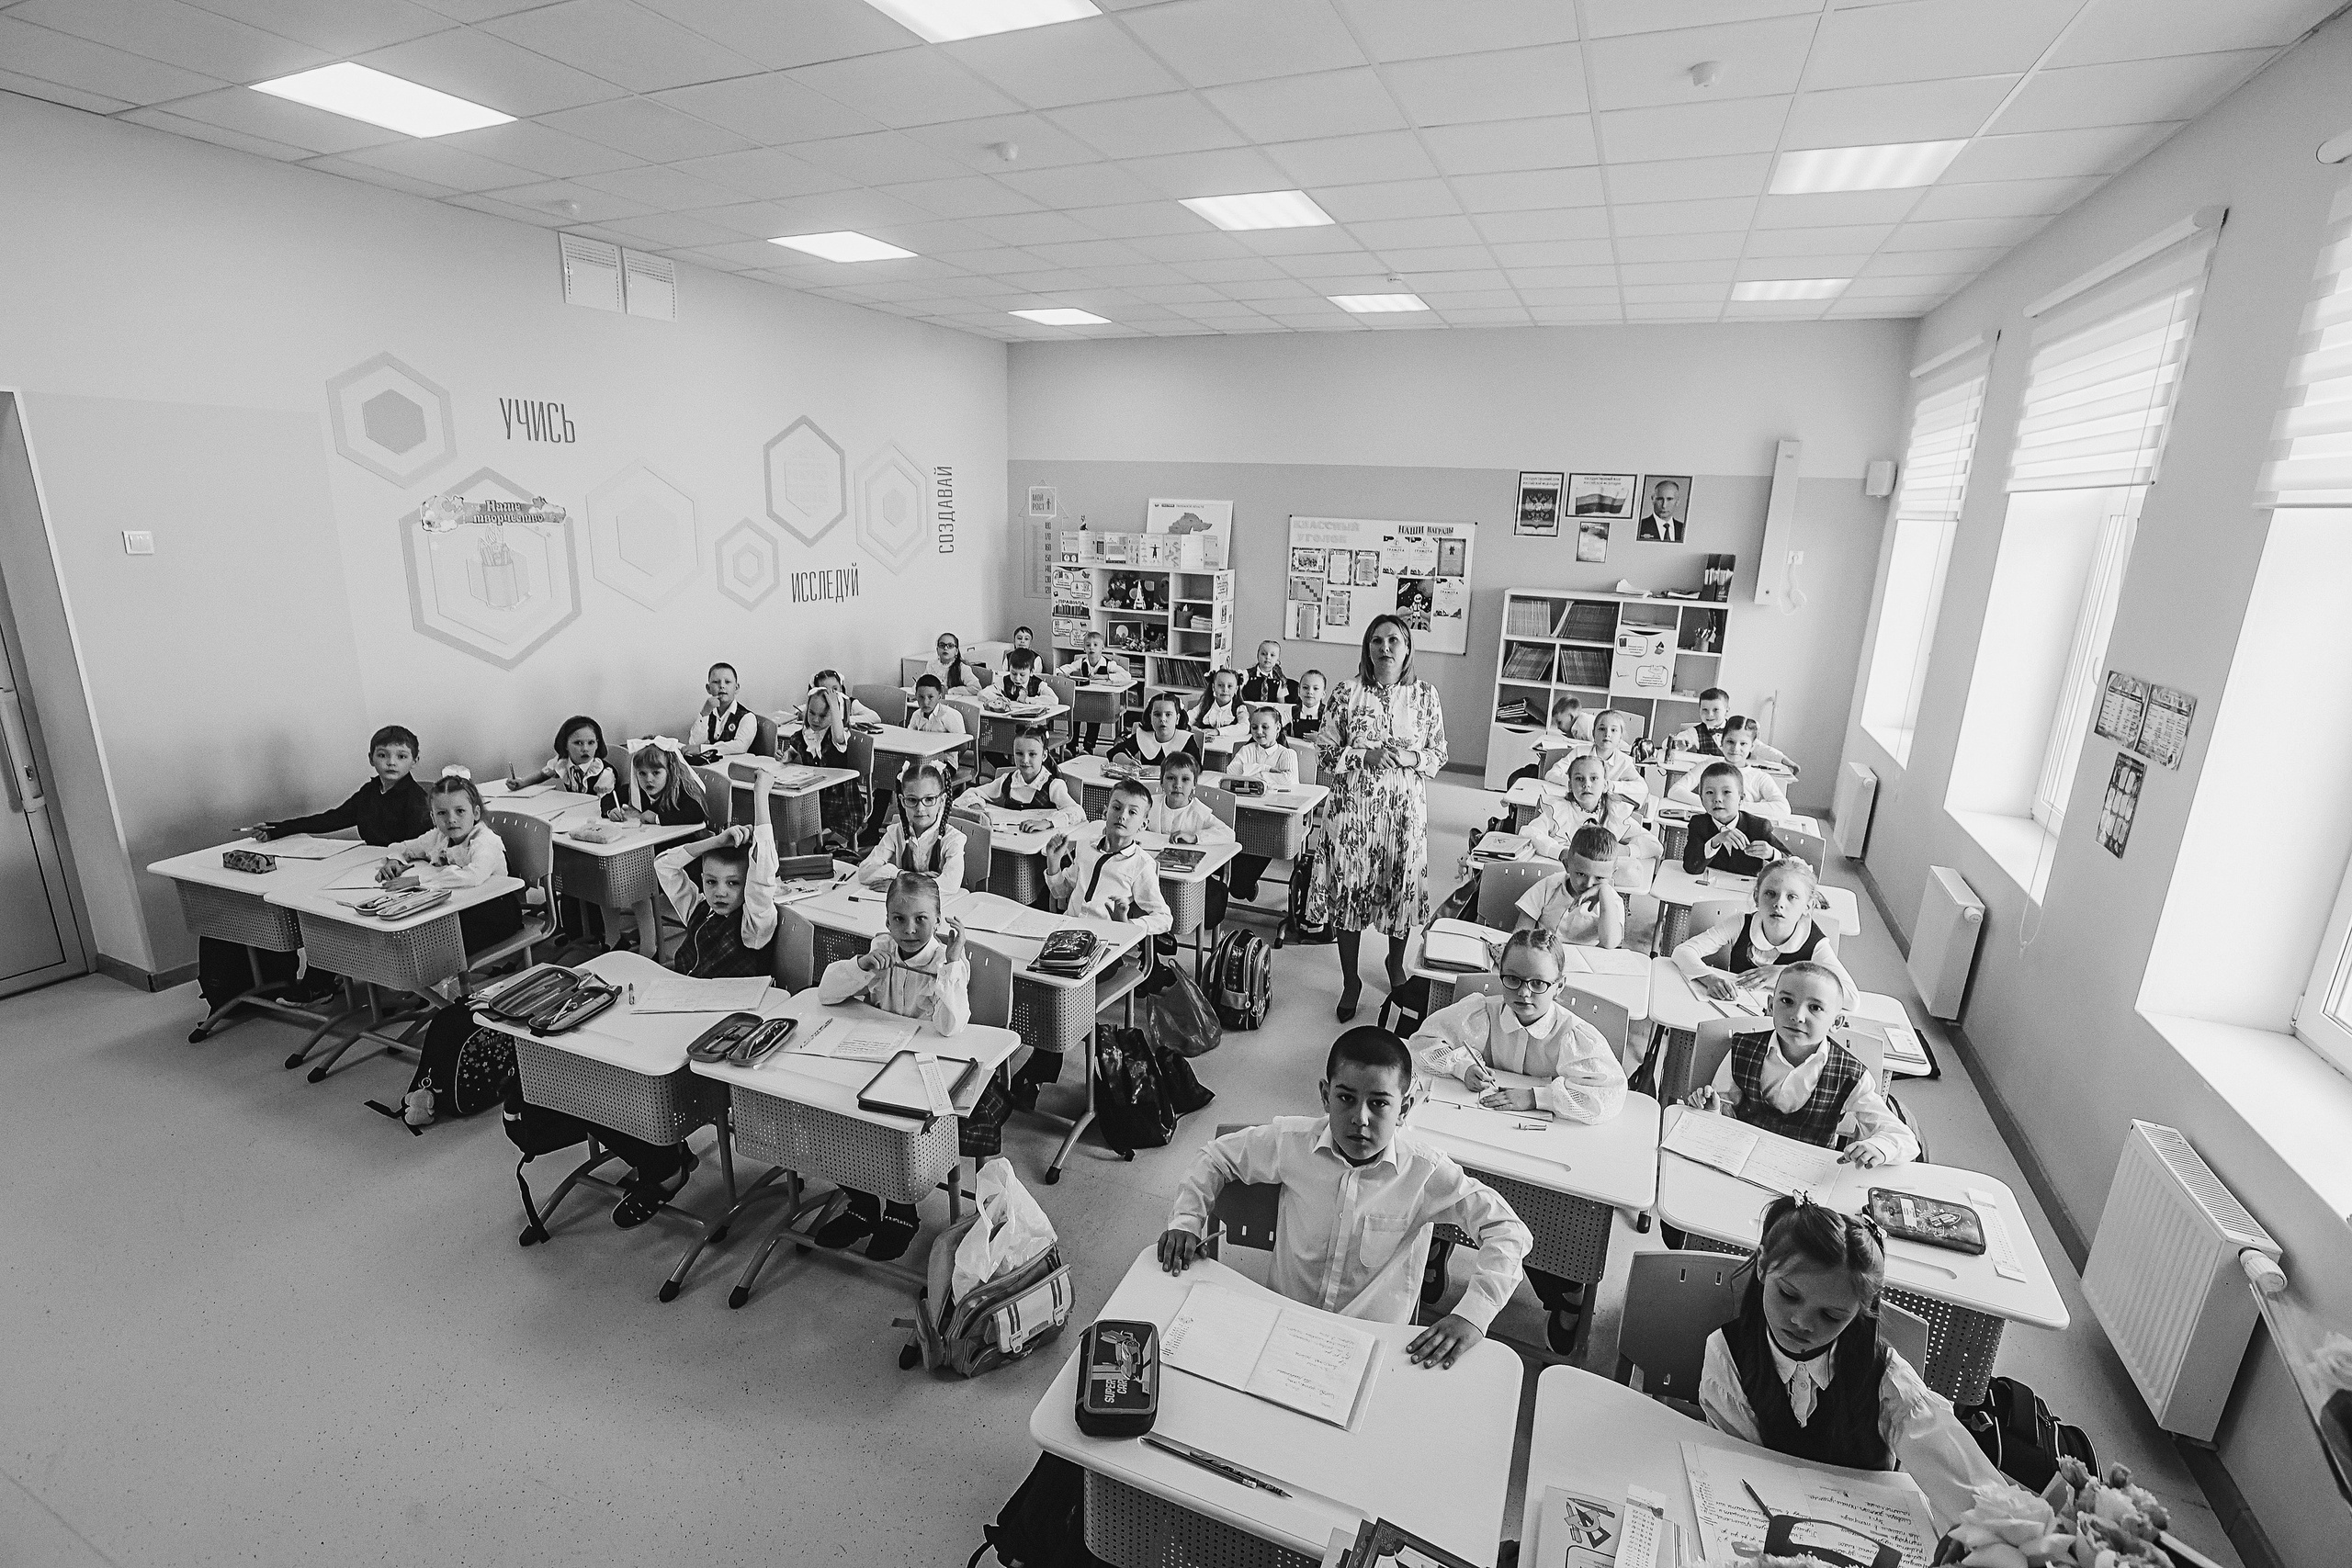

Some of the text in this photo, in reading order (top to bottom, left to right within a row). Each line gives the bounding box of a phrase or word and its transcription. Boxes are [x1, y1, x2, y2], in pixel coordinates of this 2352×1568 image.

[499, 397, 576, 444] УЧИСЬ
[1032, 492, 1045, 502] МОЙ
[485, 500, 522, 513] Наше
[933, 465, 956, 554] СОЗДАВАЙ
[1032, 502, 1045, 511] РОСТ
[472, 513, 545, 526] творчество
[1398, 525, 1454, 536] НАШИ НАГРАДЫ
[791, 562, 860, 604] ИССЛЕДУЙ
[1104, 1380, 1116, 1403] SUPER
[1116, 1380, 1127, 1394] CAR
